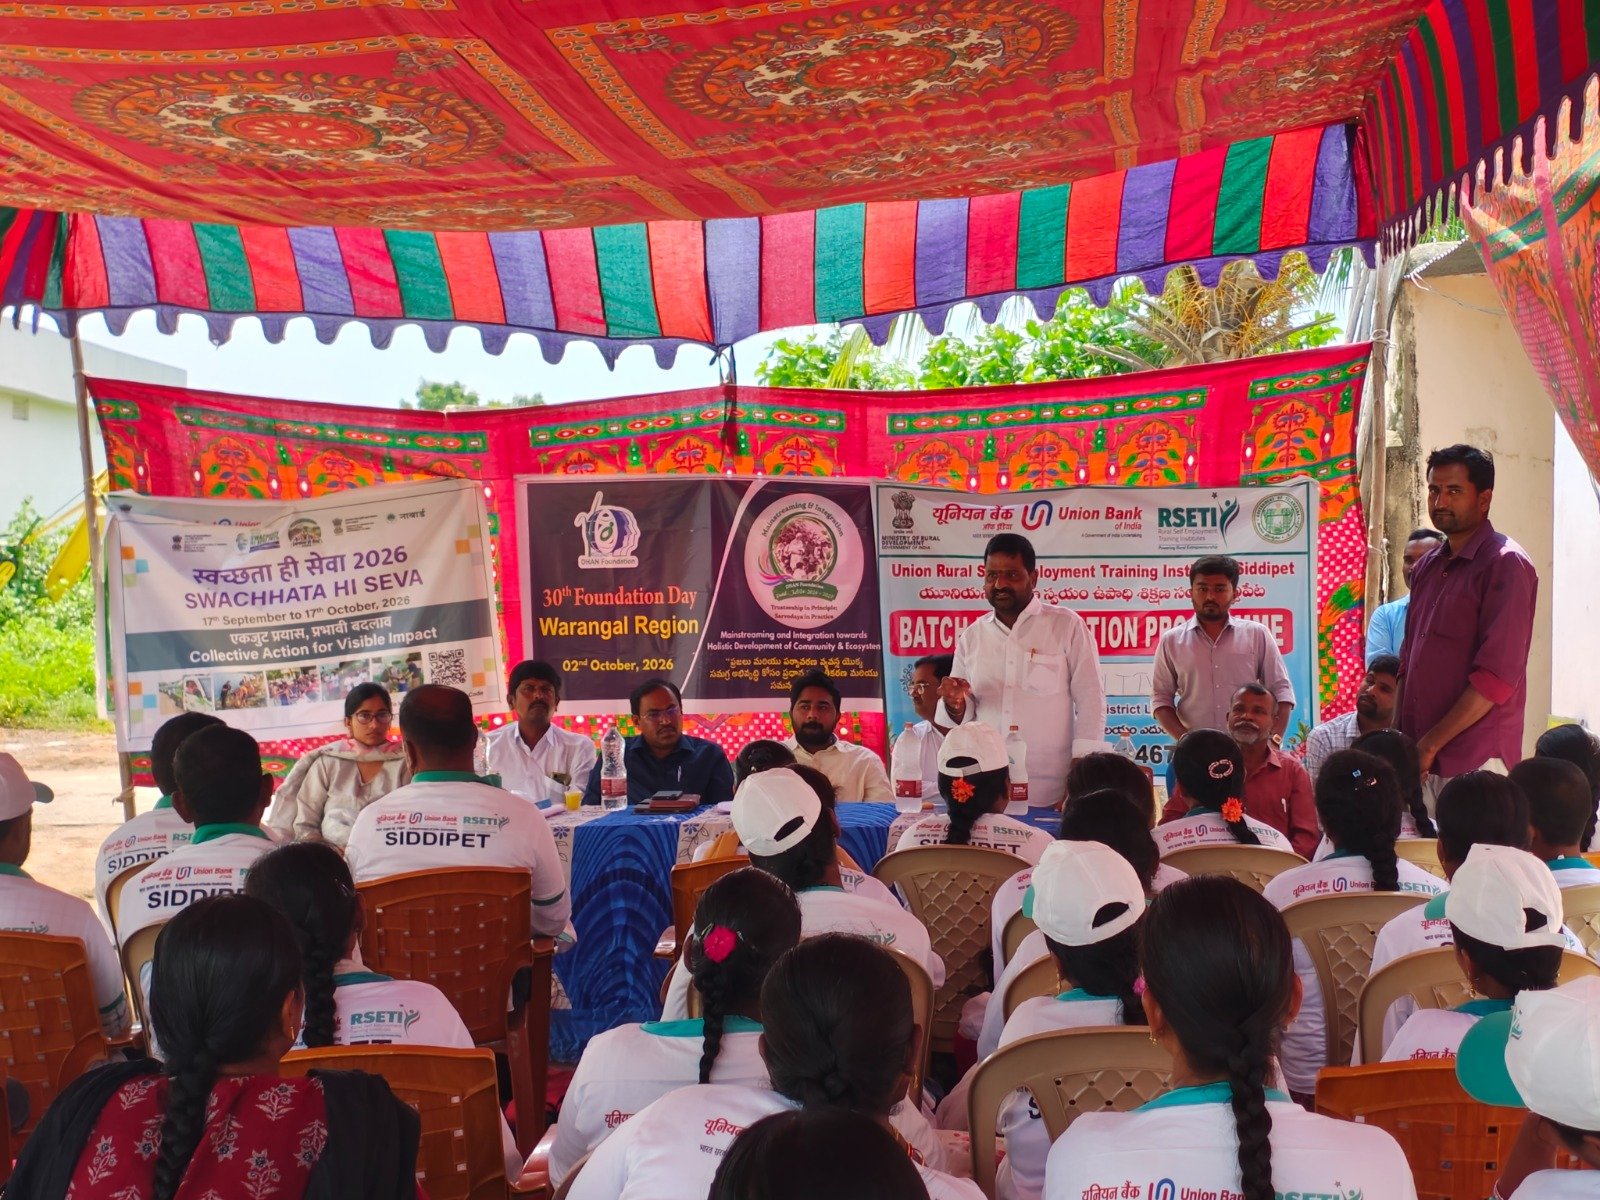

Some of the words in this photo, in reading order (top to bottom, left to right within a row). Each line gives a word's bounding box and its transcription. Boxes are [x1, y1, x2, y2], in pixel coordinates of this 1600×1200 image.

[762, 502, 806, 537] Mainstreaming
[815, 504, 844, 537] Integration
[932, 503, 986, 524] यूनियन
[990, 504, 1015, 520] बैंक
[1059, 507, 1100, 520] Union
[1105, 507, 1142, 520] Bank
[1157, 507, 1217, 528] RSETI
[1114, 522, 1123, 530] of
[1123, 522, 1142, 530] India
[192, 563, 272, 585] स्वच्छता
[278, 556, 299, 582] ही
[305, 552, 346, 577] सेवा
[353, 545, 408, 570] 2026
[891, 563, 931, 577] Union
[936, 563, 972, 577] Rural
[1038, 565, 1096, 581] loyment
[1100, 564, 1158, 581] Training
[184, 583, 326, 609] SWACHHATA
[334, 579, 357, 598] HI
[364, 569, 424, 593] SEVA
[1093, 586, 1133, 602] ఉపాధి
[543, 585, 571, 607] 30th
[574, 585, 664, 606] Foundation
[667, 585, 697, 610] Day
[203, 616, 219, 627] 17th
[222, 611, 287, 627] September
[290, 611, 302, 621] to
[305, 607, 324, 618] 17th
[327, 602, 379, 616] October,
[382, 596, 410, 608] 2026
[229, 631, 269, 647] एकजुट
[311, 620, 348, 638] प्रभावी
[350, 616, 392, 632] बदलाव
[538, 616, 628, 640] Warangal
[634, 615, 699, 639] Region
[720, 630, 774, 640] Mainstreaming
[776, 631, 791, 639] and
[793, 630, 834, 641] Integration
[836, 630, 868, 639] towards
[900, 616, 968, 648] BATCH
[189, 648, 259, 664] Collective
[262, 644, 309, 660] Action
[312, 642, 334, 653] for
[336, 634, 386, 651] Visible
[389, 627, 437, 645] Impact
[707, 641, 733, 650] Holistic
[734, 641, 782, 651] Development
[783, 641, 792, 650] of
[793, 641, 835, 652] Community
[837, 641, 844, 650] &
[562, 658, 588, 672] 02nd
[590, 658, 639, 672] October,
[642, 658, 674, 671] 2026
[1106, 704, 1140, 714] istrict
[463, 816, 497, 826] RSETI
[385, 831, 491, 848] SIDDIPET
[1249, 827, 1273, 836] SETI
[193, 867, 213, 875] Union
[214, 867, 232, 875] Bank
[1350, 881, 1369, 889] Union
[350, 1011, 403, 1026] RSETI
[1180, 1187, 1217, 1200] Union
